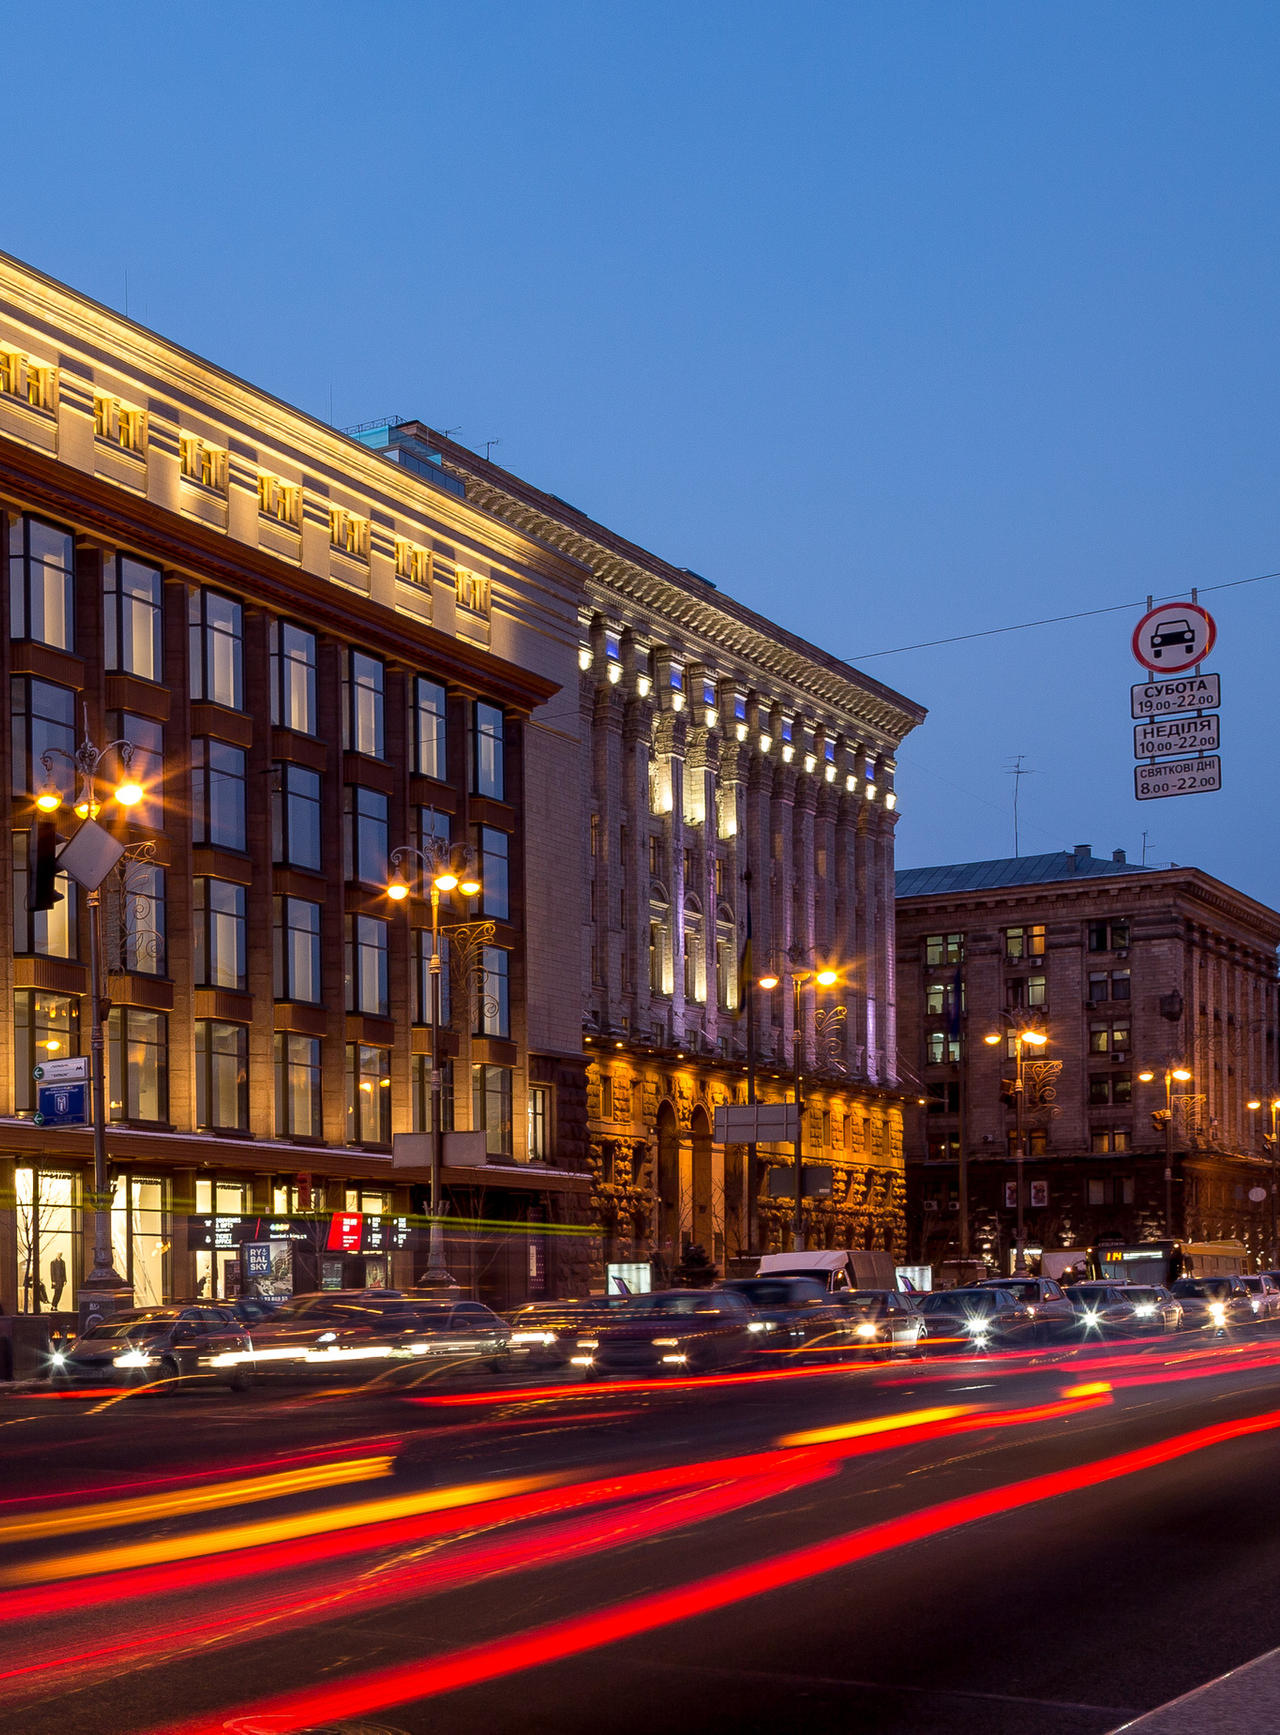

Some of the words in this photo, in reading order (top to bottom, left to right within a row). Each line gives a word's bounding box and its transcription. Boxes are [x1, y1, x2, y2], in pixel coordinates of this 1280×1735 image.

[1144, 679, 1208, 698] СУБОТА
[1143, 719, 1211, 739] НЕДІЛЯ
[1140, 763, 1194, 779] СВЯТКОВІ
[1196, 760, 1215, 773] ДНІ
[250, 1263, 268, 1271] SKY
